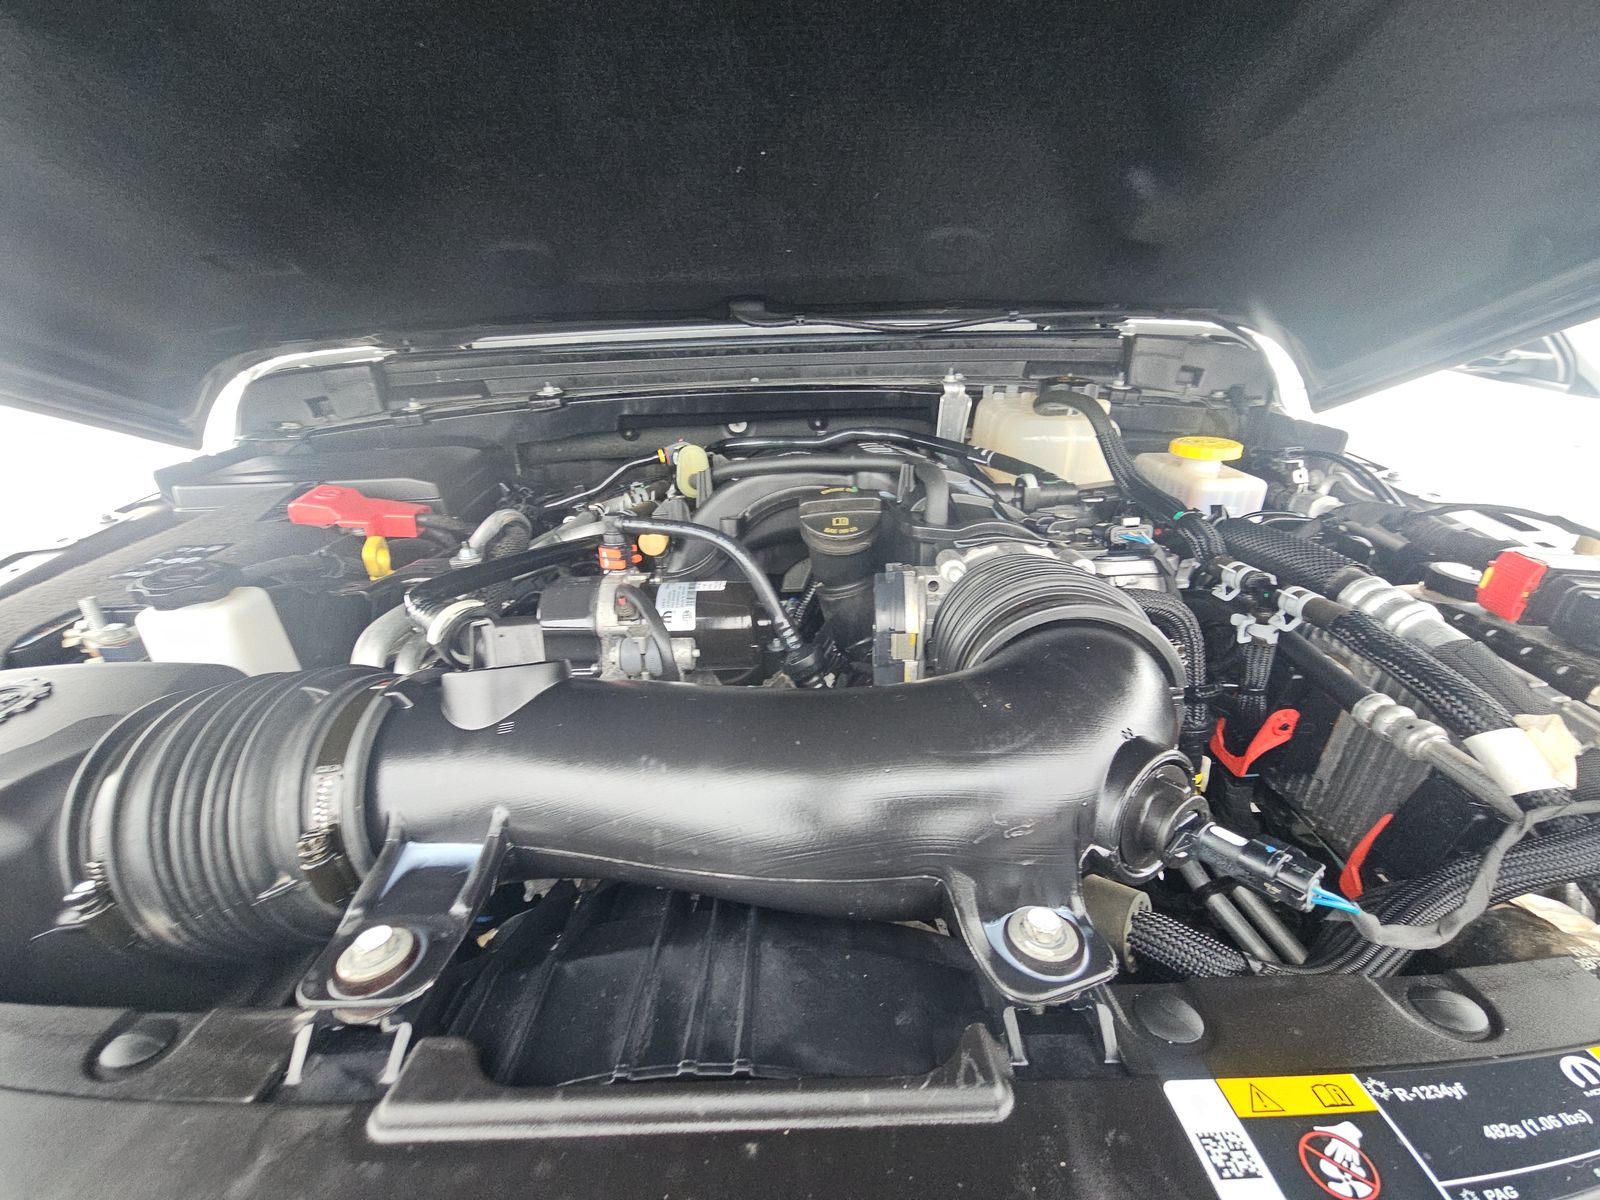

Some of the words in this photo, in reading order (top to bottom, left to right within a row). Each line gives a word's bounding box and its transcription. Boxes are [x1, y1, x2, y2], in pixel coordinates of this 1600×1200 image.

[1392, 1082, 1468, 1102] R-1234yf
[1483, 1123, 1527, 1139] 482g
[1521, 1113, 1563, 1136] (1.06
[1558, 1109, 1594, 1125] lbs)
[1483, 1185, 1519, 1200] PAG
